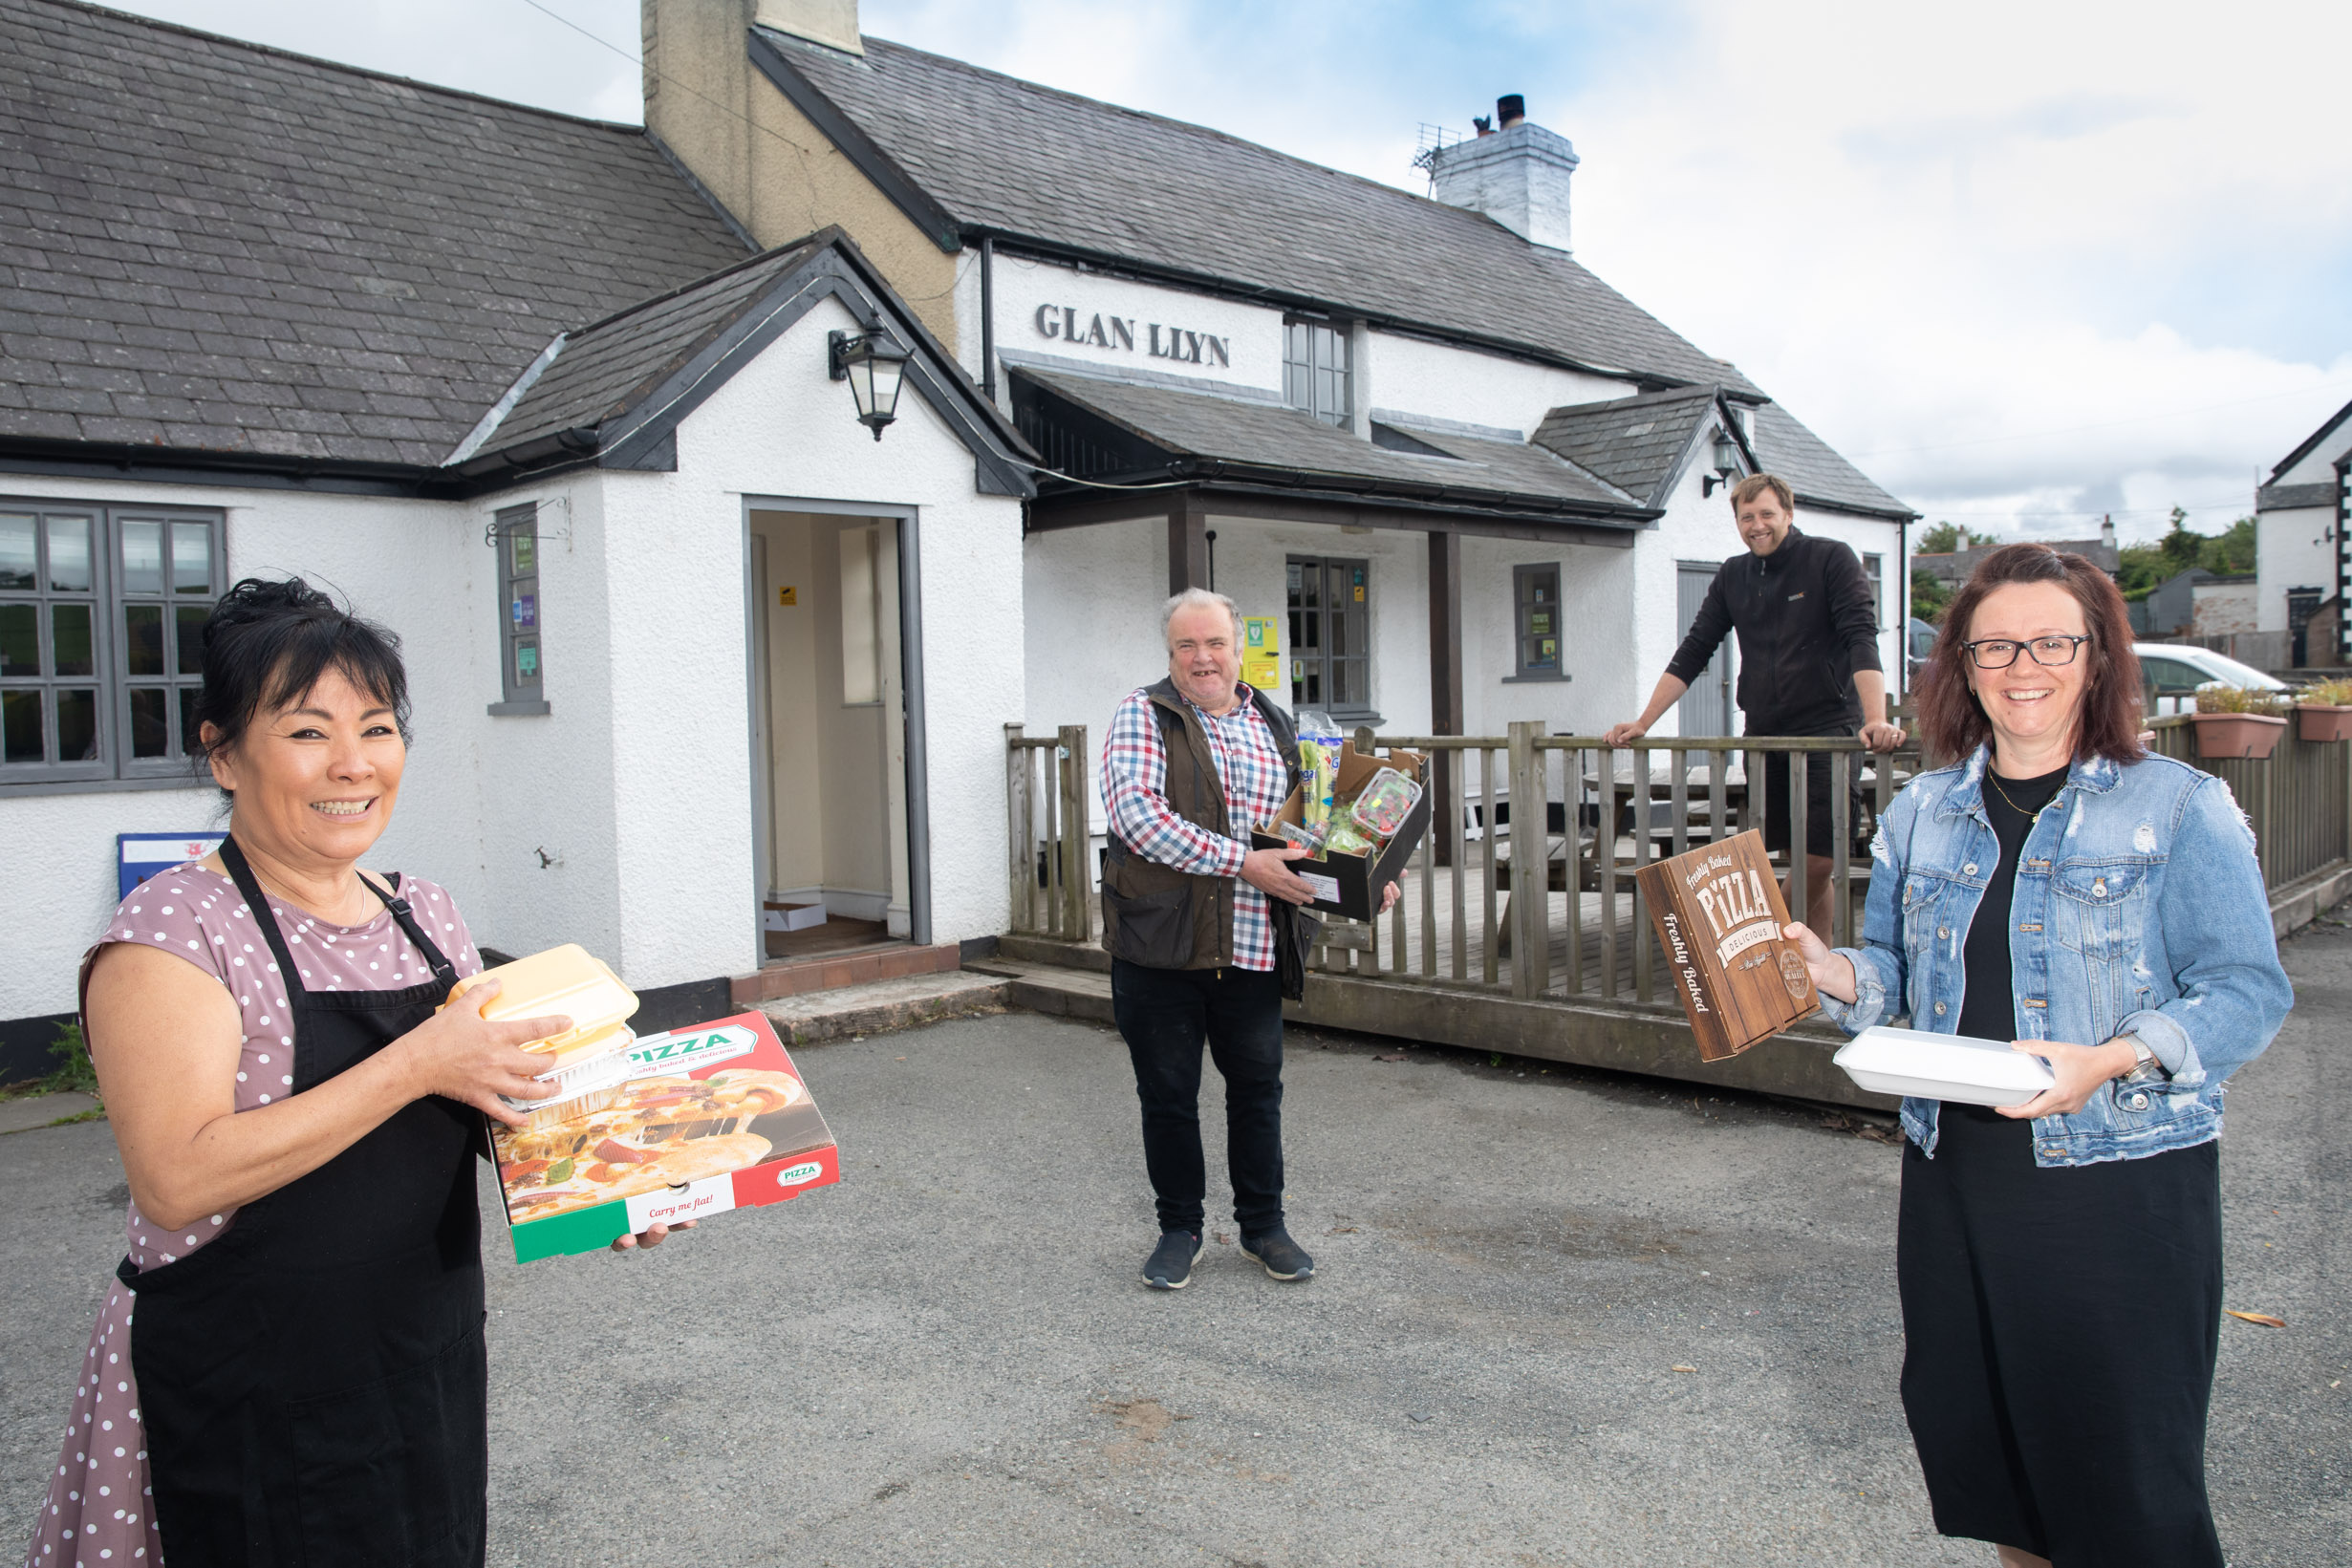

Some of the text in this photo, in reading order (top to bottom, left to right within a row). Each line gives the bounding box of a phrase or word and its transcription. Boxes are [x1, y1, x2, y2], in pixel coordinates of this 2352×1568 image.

[1035, 304, 1229, 368] GLAN LLYN
[1686, 853, 1732, 891] Freshly Baked
[1729, 928, 1768, 952] DELICIOUS
[1663, 913, 1709, 1014] Freshly Baked
[659, 1059, 685, 1069] baked
[699, 1047, 737, 1060] delicious
[785, 1166, 815, 1179] PIZZA
[649, 1194, 713, 1218] Carry me flat!
